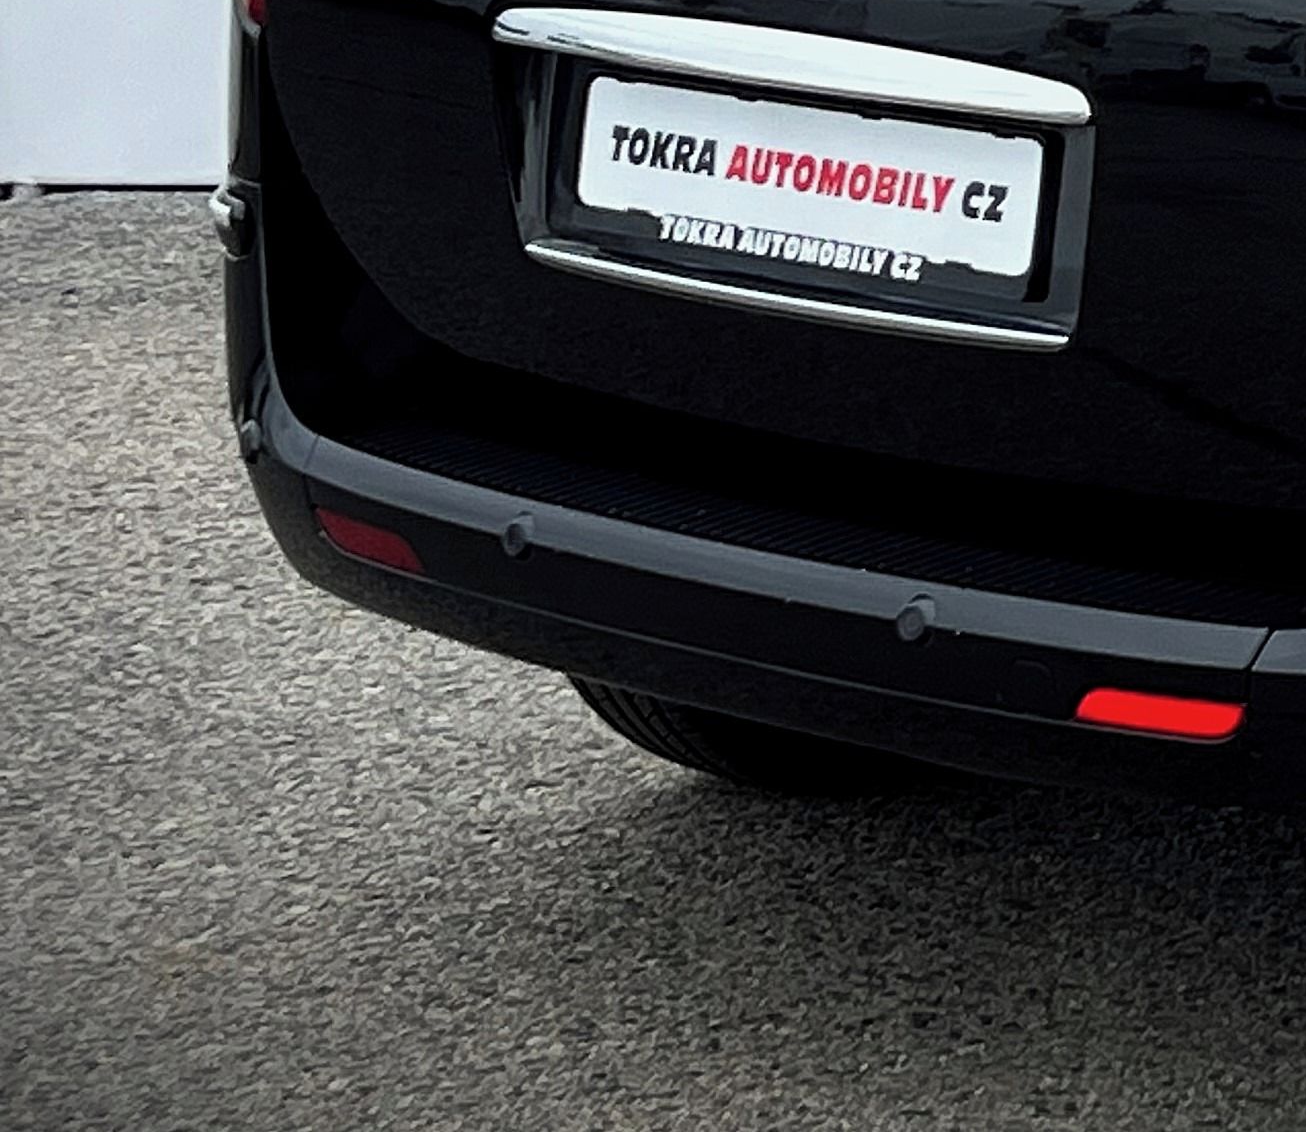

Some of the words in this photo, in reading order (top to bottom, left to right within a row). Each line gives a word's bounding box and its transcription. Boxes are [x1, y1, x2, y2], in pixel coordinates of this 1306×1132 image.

[611, 125, 718, 176] TOKRA
[725, 144, 955, 214] AUTOMOBILY
[961, 181, 1010, 222] CZ
[658, 214, 735, 250] TOKRA
[737, 227, 889, 277] AUTOMOBILY
[890, 251, 924, 282] CZ
